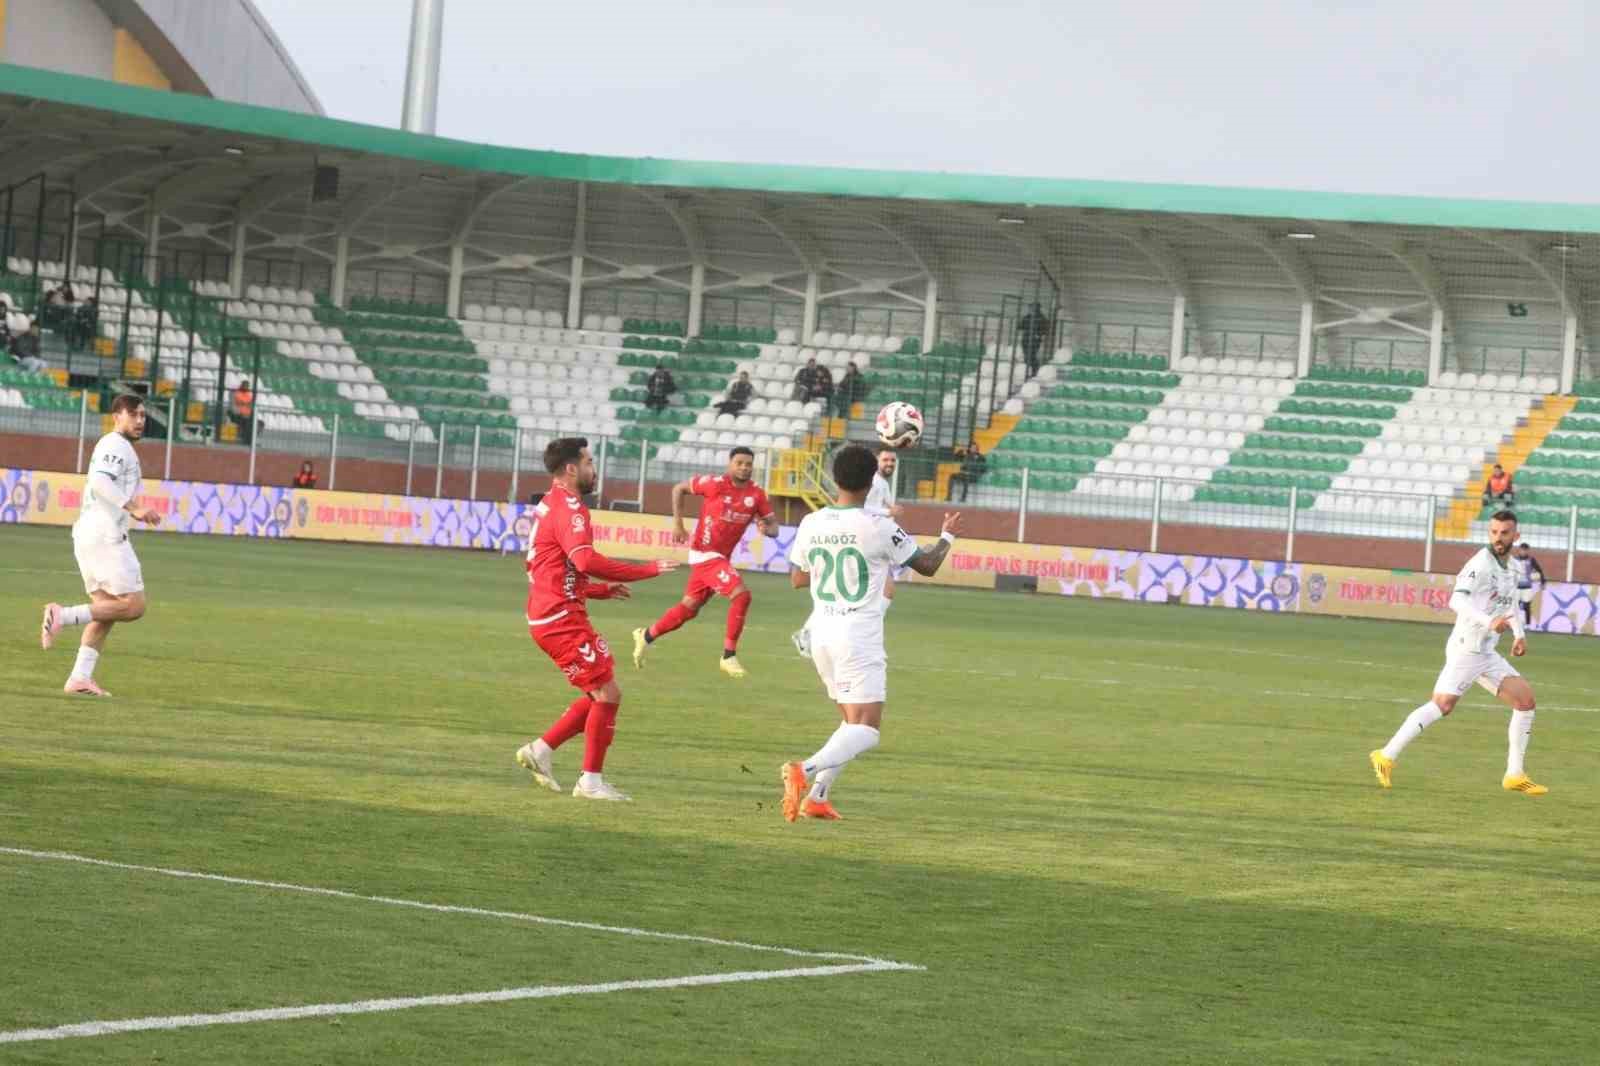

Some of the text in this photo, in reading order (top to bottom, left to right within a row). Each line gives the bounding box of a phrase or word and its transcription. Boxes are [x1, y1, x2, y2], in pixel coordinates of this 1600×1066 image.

[615, 526, 654, 545] POLİS
[810, 533, 857, 545] ALAGÖZ
[808, 546, 870, 602] 20
